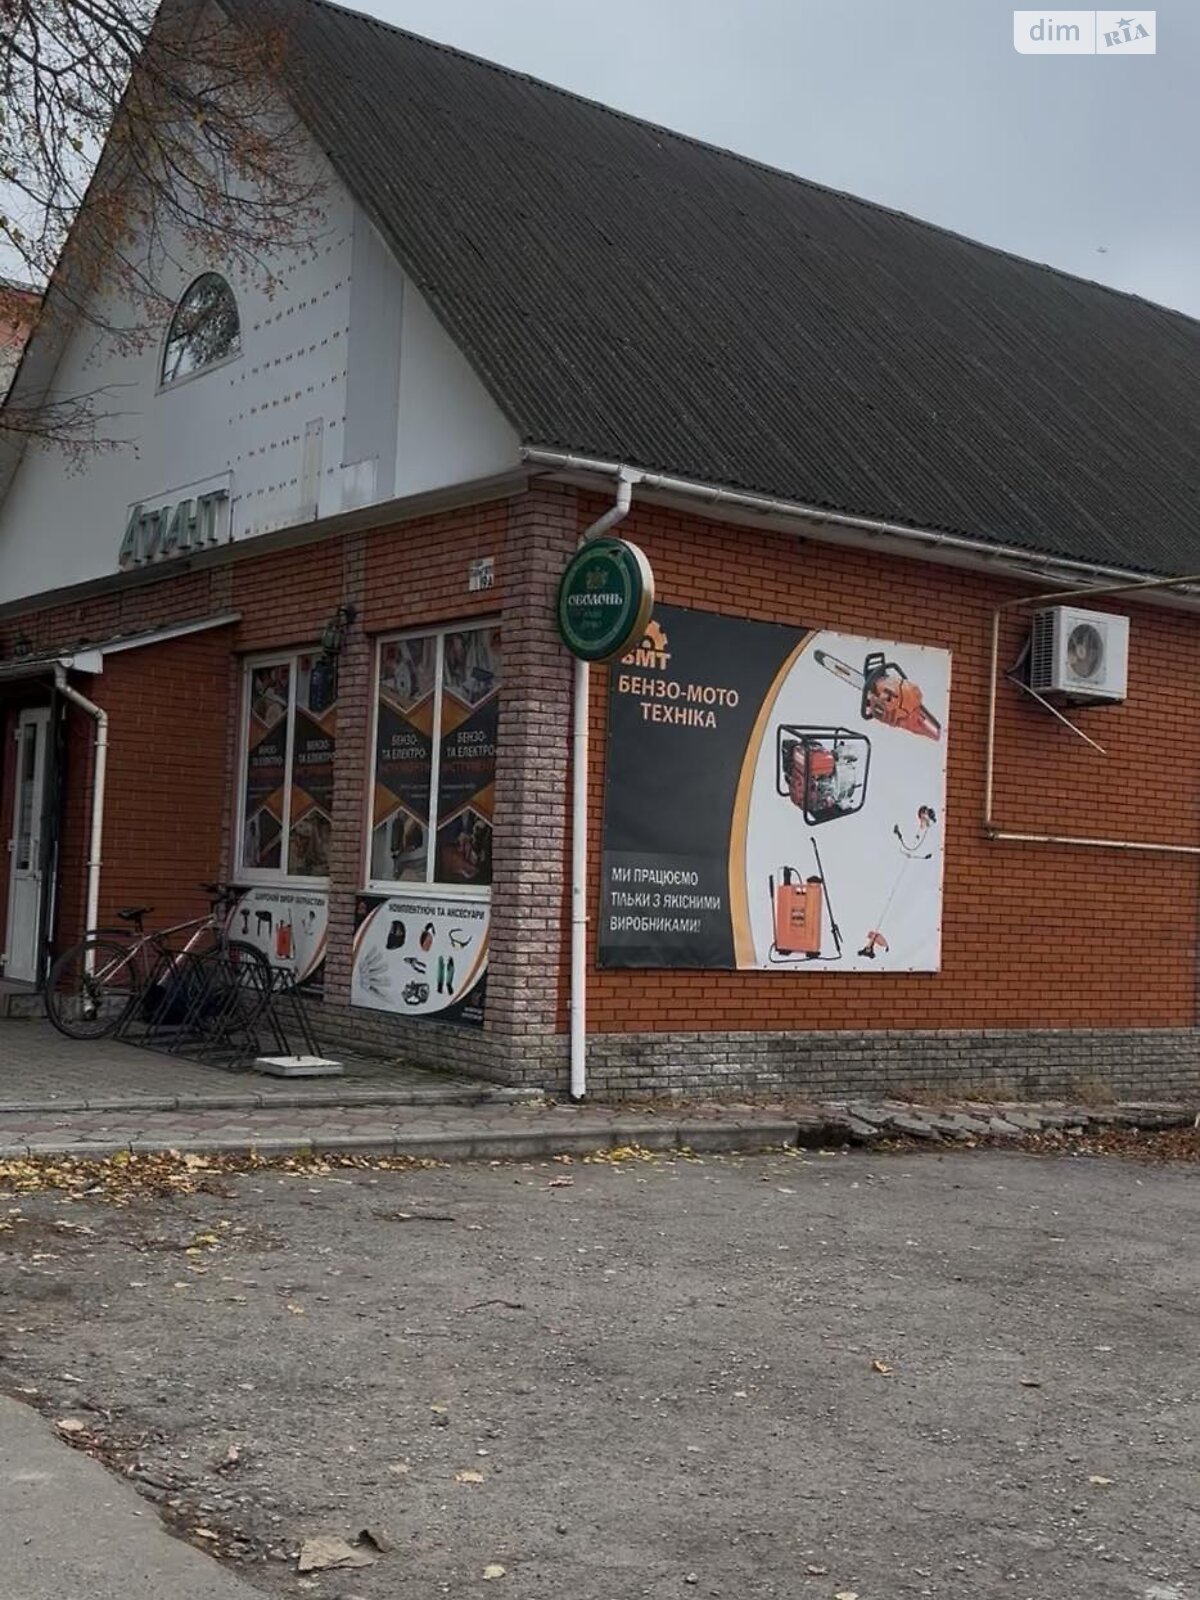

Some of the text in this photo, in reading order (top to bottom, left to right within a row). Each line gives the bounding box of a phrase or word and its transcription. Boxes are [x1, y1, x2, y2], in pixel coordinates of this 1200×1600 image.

[618, 675, 740, 708] БЕНЗО-МОТО
[640, 702, 717, 729] ТЕХНІКА
[611, 867, 699, 887] МИ ПРАЦЮЄМО
[611, 891, 721, 910] ТІЛЬКИ З ЯКІСНИМИ
[610, 916, 701, 934] ВИРОБНИКАМИ!
